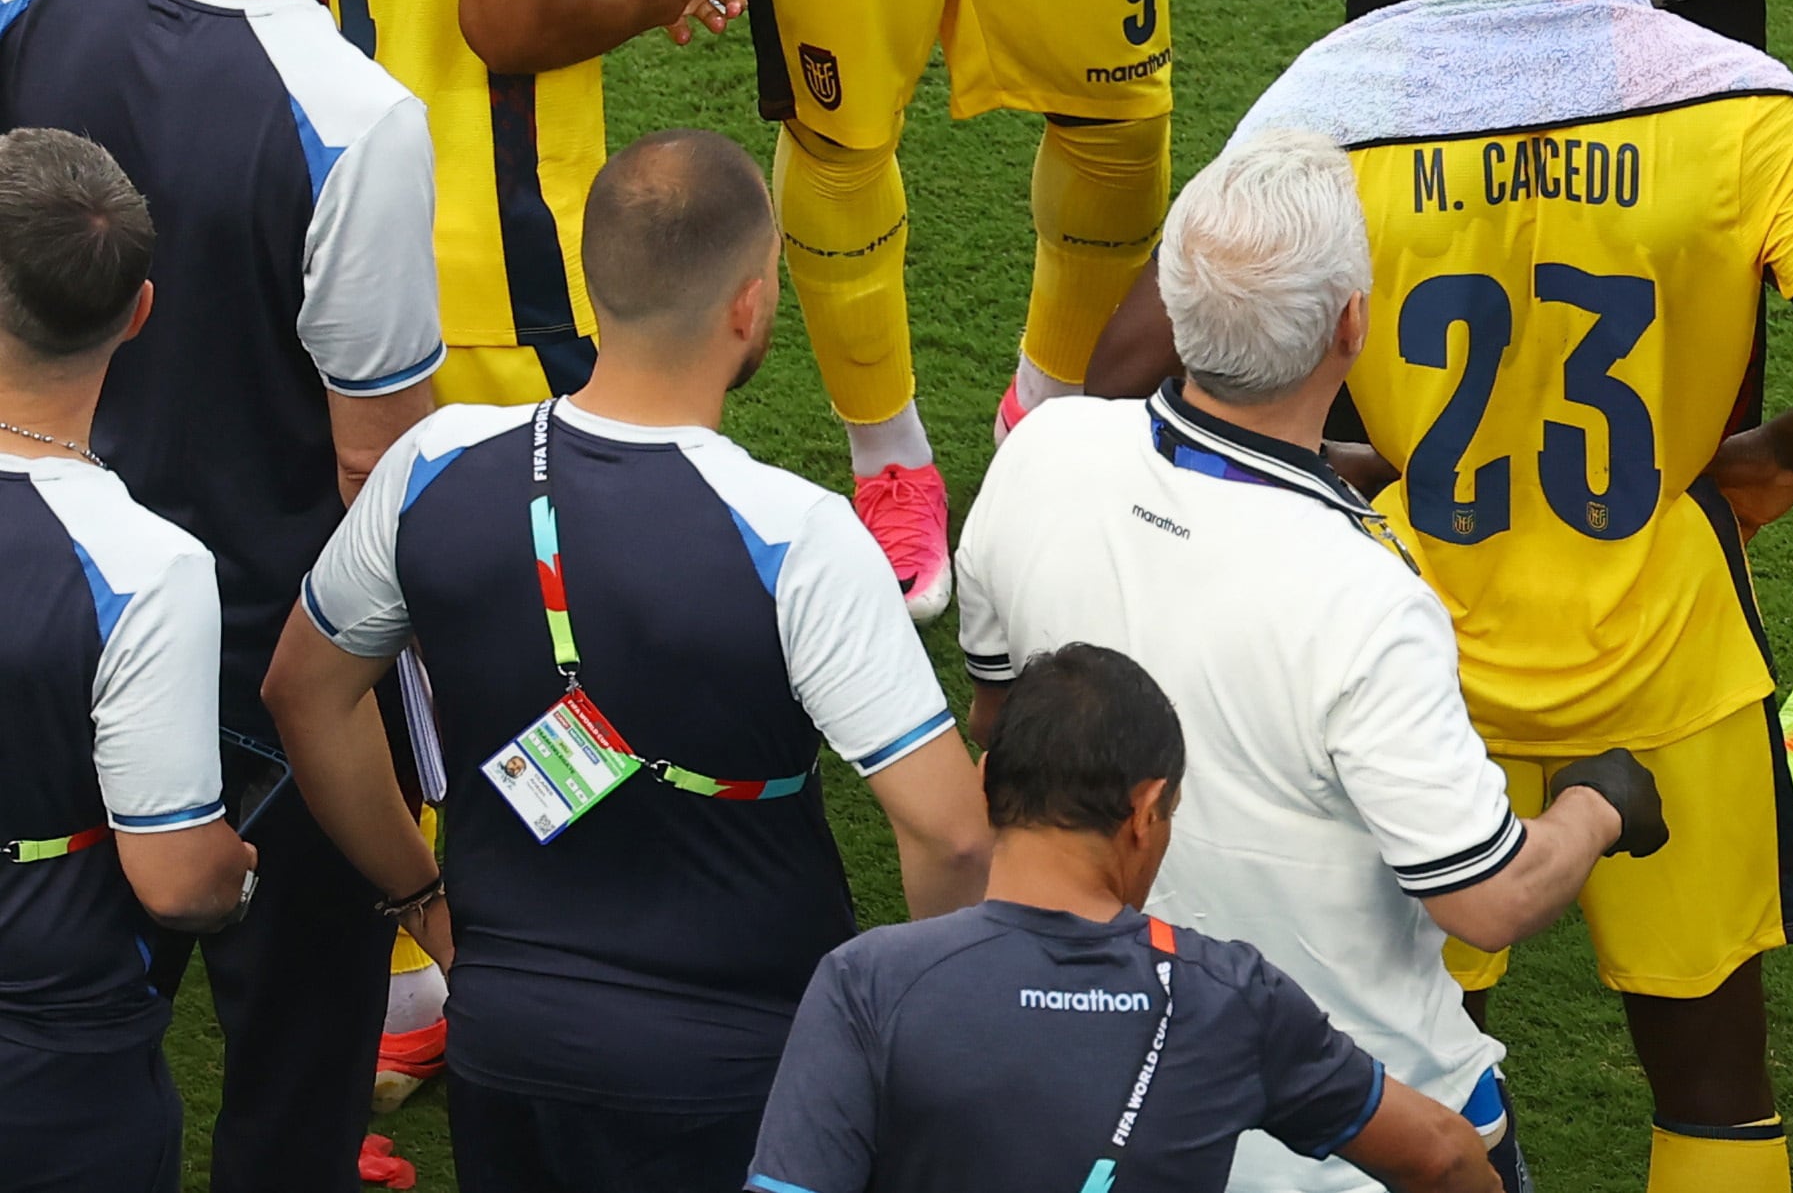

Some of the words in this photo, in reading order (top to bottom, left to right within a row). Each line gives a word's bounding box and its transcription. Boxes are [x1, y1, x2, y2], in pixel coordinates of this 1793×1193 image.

[1086, 48, 1172, 83] marathon
[1414, 148, 1464, 213] M.
[1483, 137, 1640, 208] CAICEDO
[1398, 263, 1661, 545] 23
[533, 446, 548, 481] FIFA
[1132, 504, 1191, 540] marathon
[1020, 988, 1149, 1013] marathon
[1112, 1110, 1138, 1147] FIFA
[1127, 1050, 1159, 1110] WORLD
[1152, 1016, 1168, 1050] CUP
